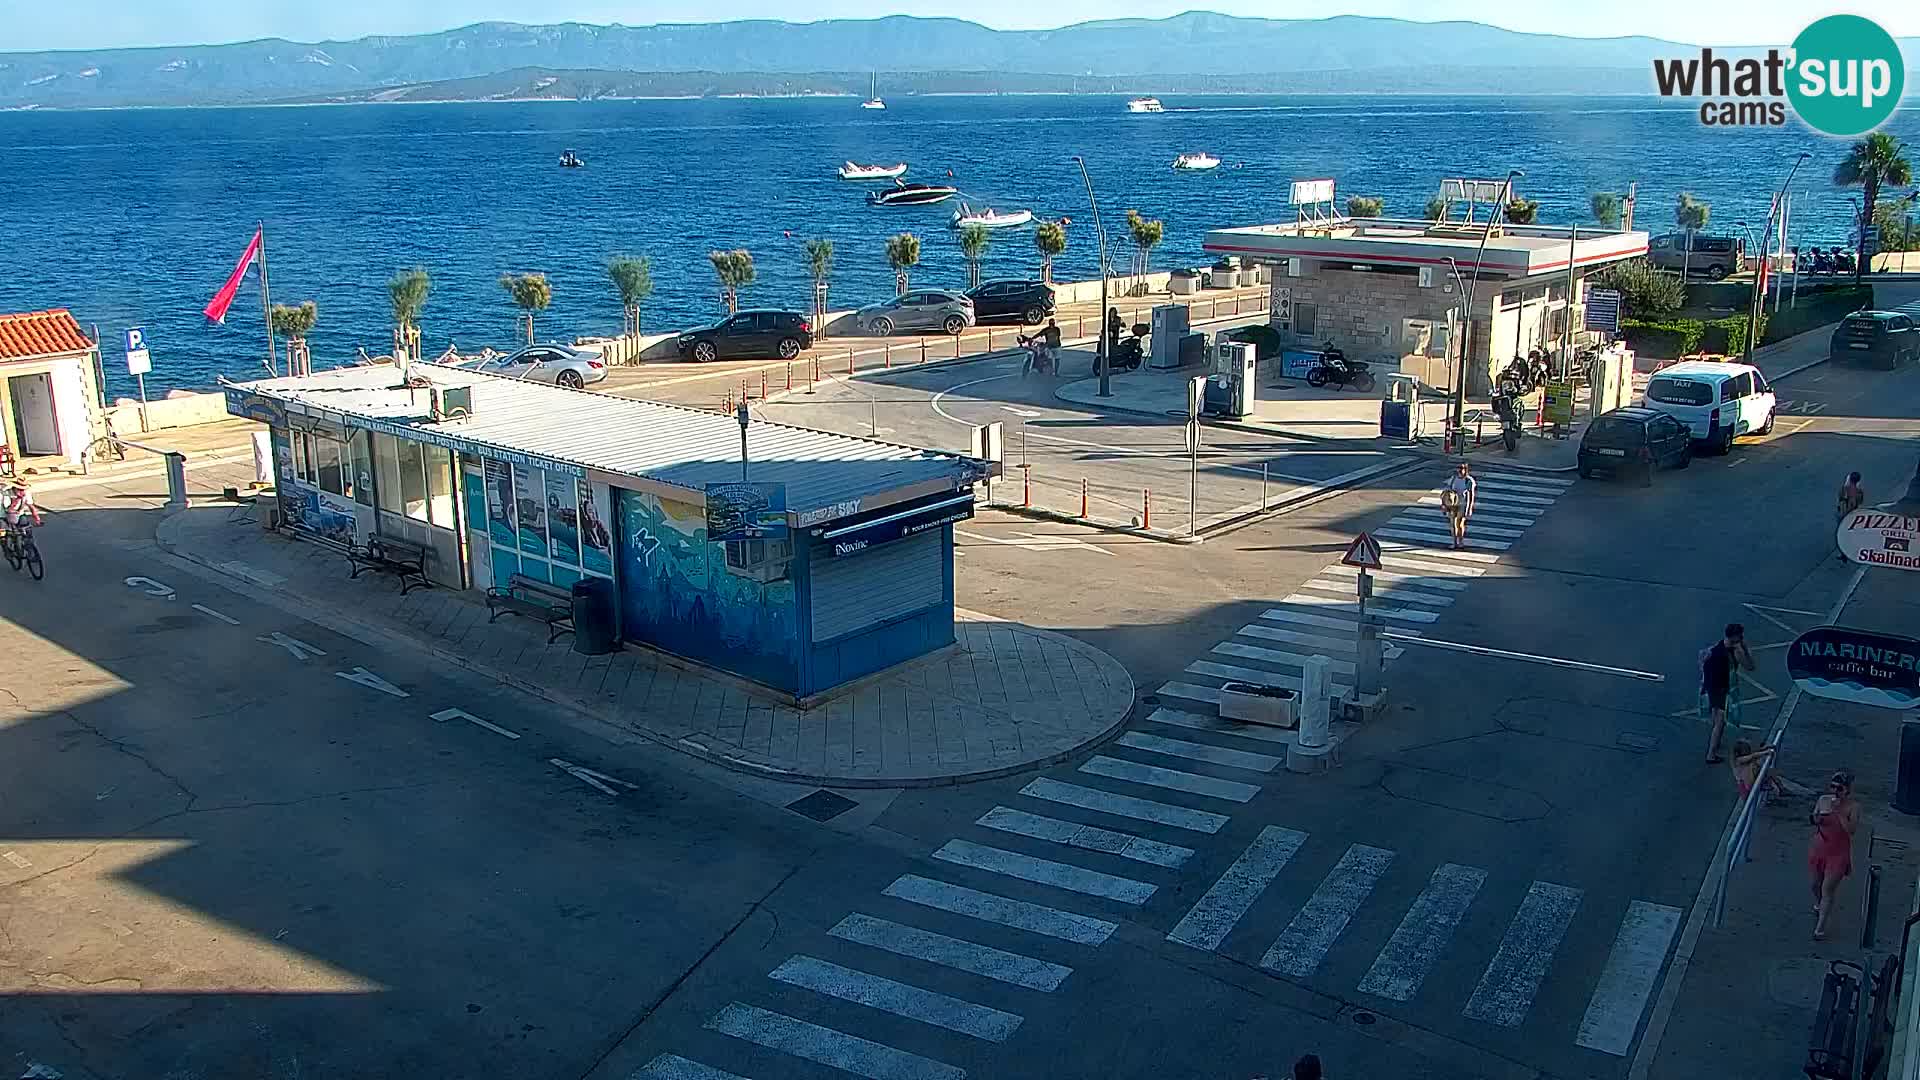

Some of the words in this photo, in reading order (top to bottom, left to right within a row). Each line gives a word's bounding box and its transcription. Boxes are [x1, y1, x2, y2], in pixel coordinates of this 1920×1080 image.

[128, 330, 142, 349] P
[435, 436, 468, 452] POSTAJA
[478, 447, 493, 457] BUS
[494, 449, 526, 464] STATION
[528, 457, 555, 470] TICKET
[555, 463, 582, 477] OFFICE
[1881, 529, 1916, 540] GRILL
[1870, 665, 1896, 679] bar
